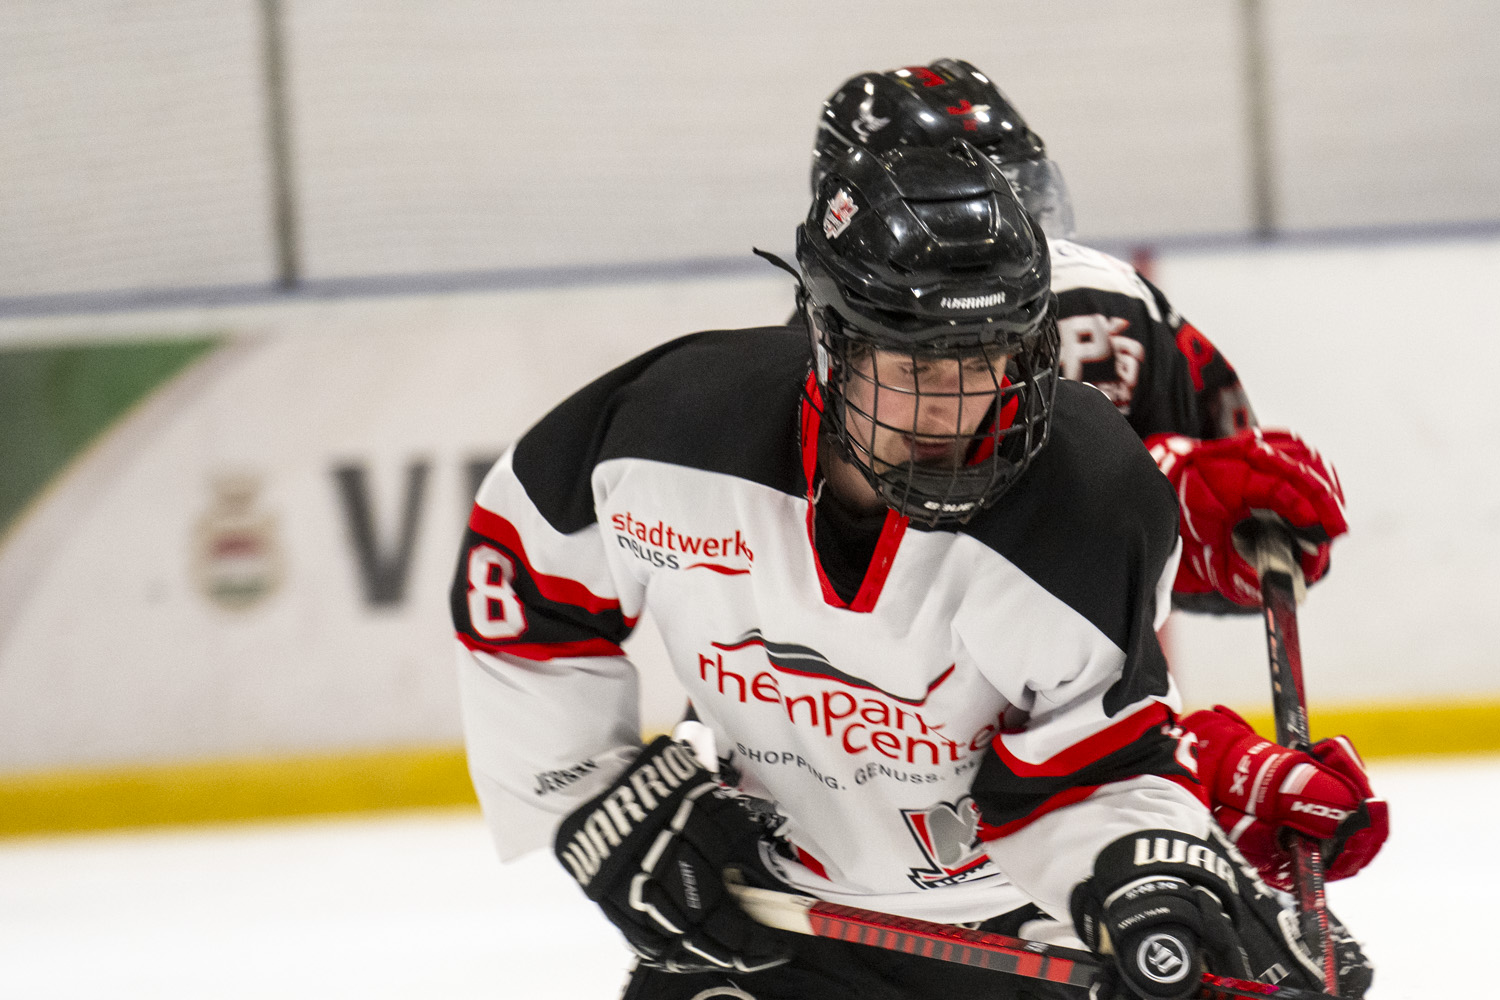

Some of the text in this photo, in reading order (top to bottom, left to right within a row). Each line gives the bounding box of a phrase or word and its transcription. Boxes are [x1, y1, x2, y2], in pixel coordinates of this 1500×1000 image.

[616, 533, 680, 570] neuss
[467, 542, 529, 641] 8
[736, 742, 847, 791] SHOPPING.
[1291, 801, 1347, 821] CCM
